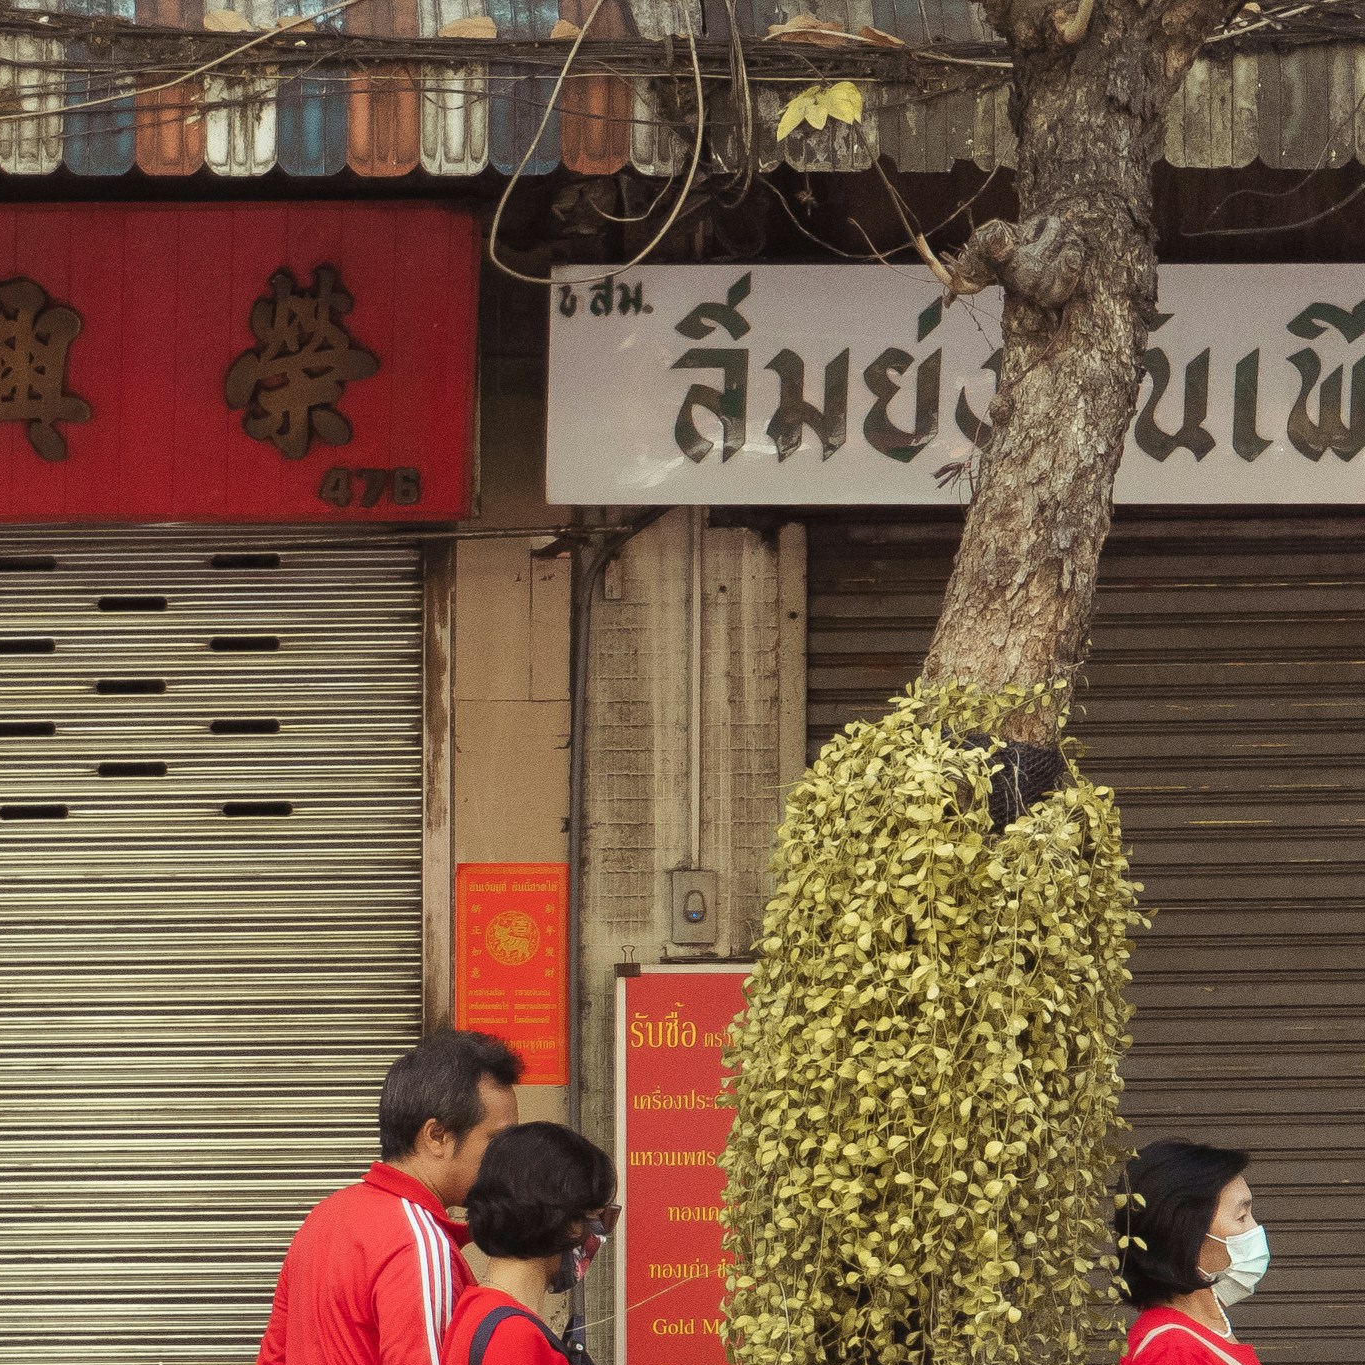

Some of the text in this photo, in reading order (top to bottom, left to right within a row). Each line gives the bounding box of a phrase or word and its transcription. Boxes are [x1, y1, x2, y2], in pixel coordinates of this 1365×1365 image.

[319, 466, 422, 507] 476
[630, 1001, 698, 1049] รับซื้อ
[630, 1151, 717, 1167] แหวนเพชร
[649, 1257, 710, 1279] ทองเก่า
[652, 1317, 696, 1335] Gold
